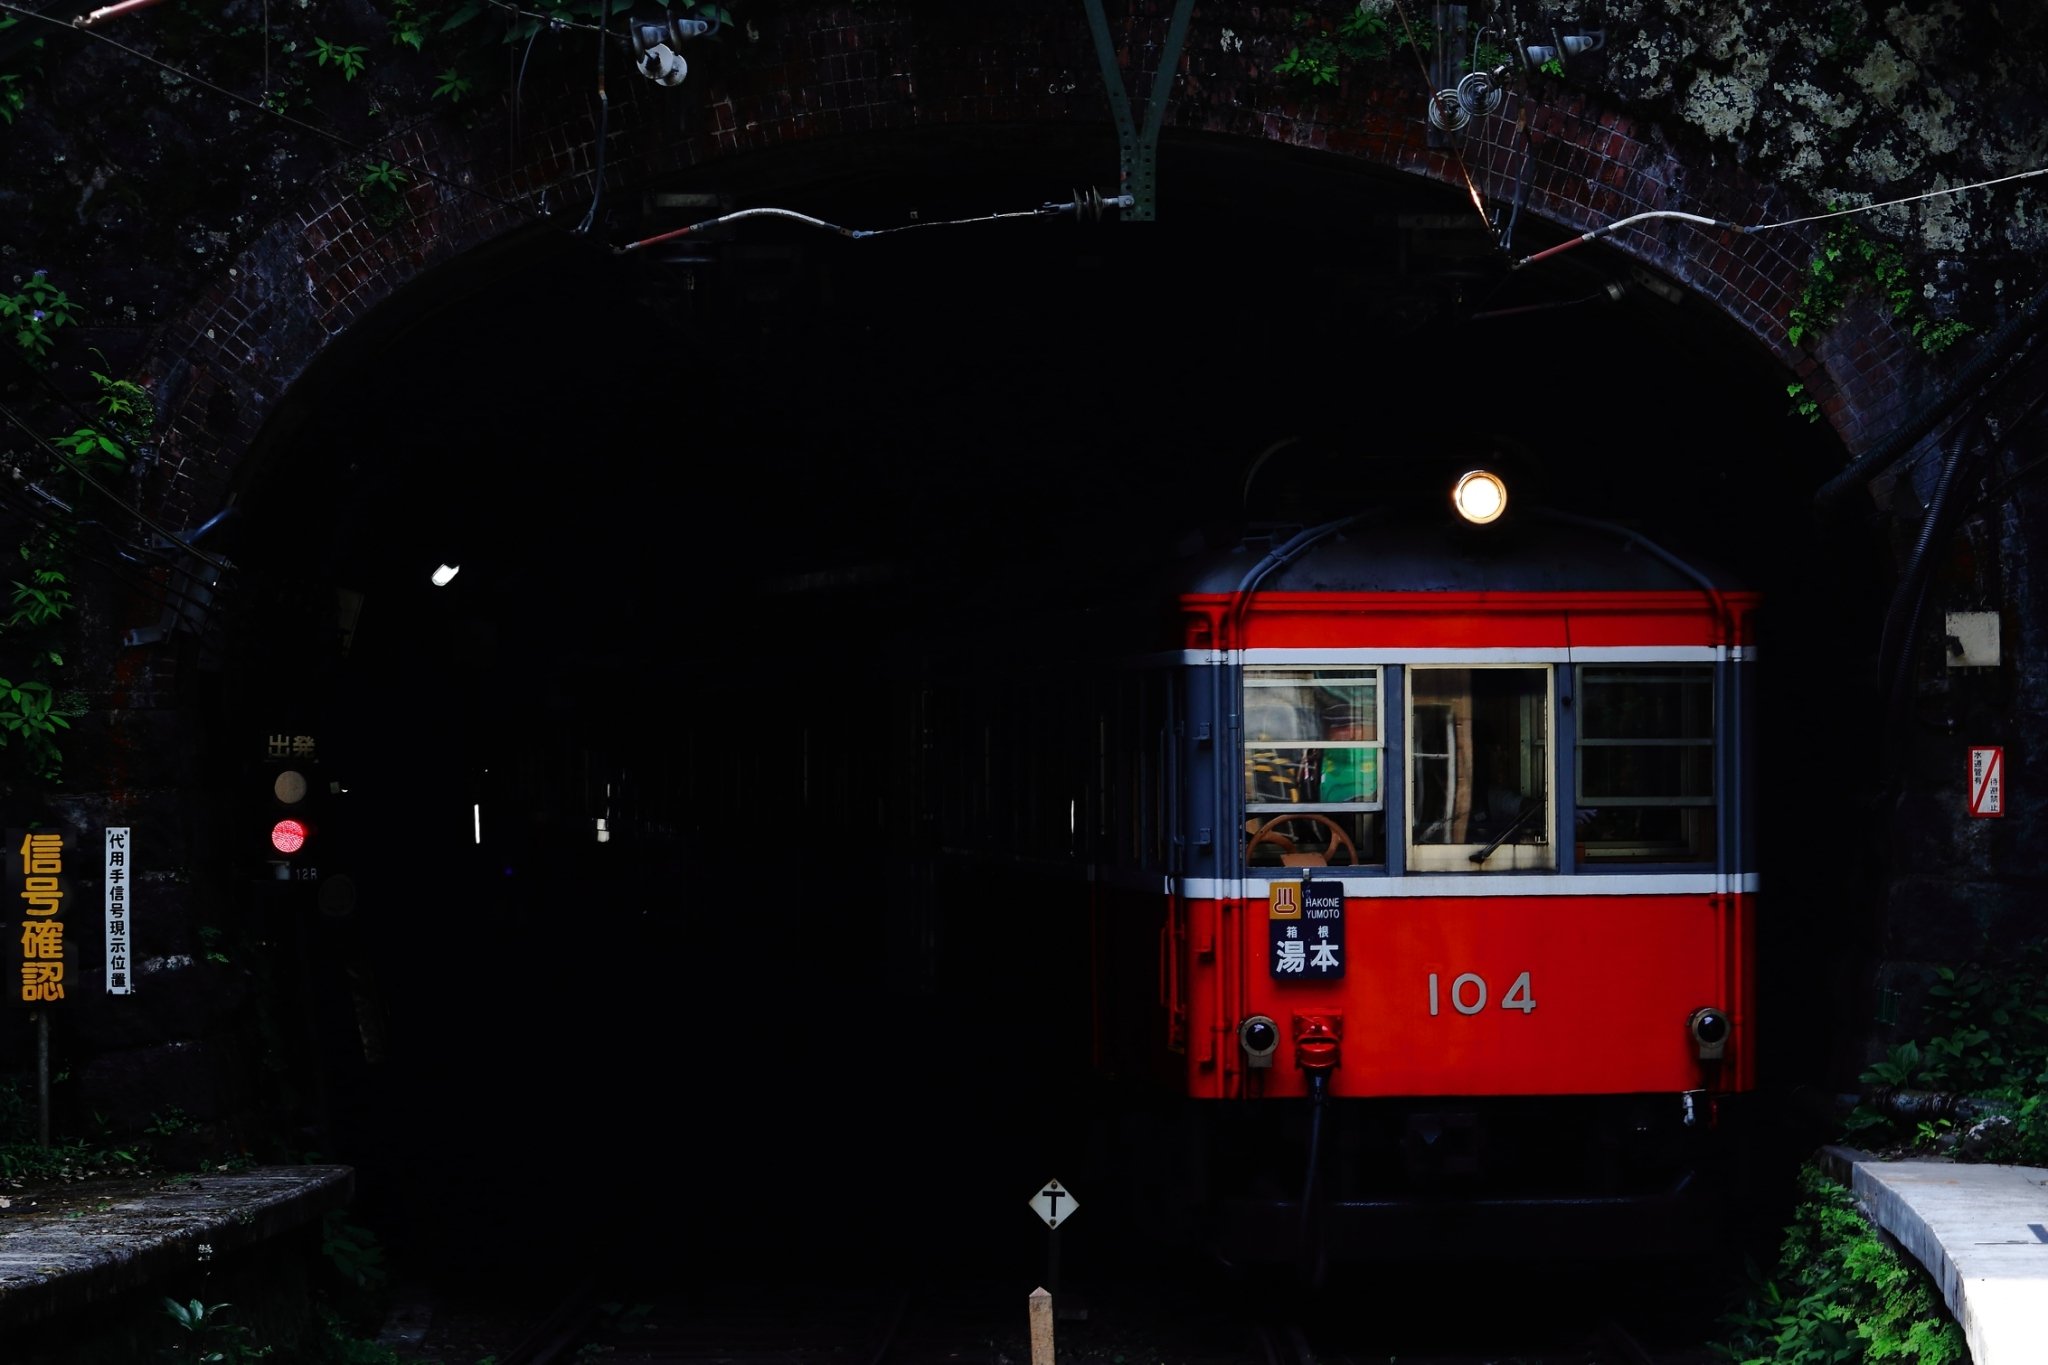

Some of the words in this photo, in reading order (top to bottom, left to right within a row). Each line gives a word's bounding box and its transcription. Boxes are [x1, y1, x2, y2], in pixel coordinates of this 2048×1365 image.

[268, 734, 316, 758] 出発
[296, 868, 318, 881] 12R
[109, 833, 127, 989] 代用手信号現示位置
[1305, 897, 1340, 908] HAKONE
[1305, 908, 1340, 919] YUMOTO
[19, 832, 65, 1002] 信号確認
[1286, 925, 1330, 938] 箱根
[1275, 939, 1340, 974] 湯本
[1428, 971, 1537, 1016] 104
[1043, 1191, 1065, 1217] T
